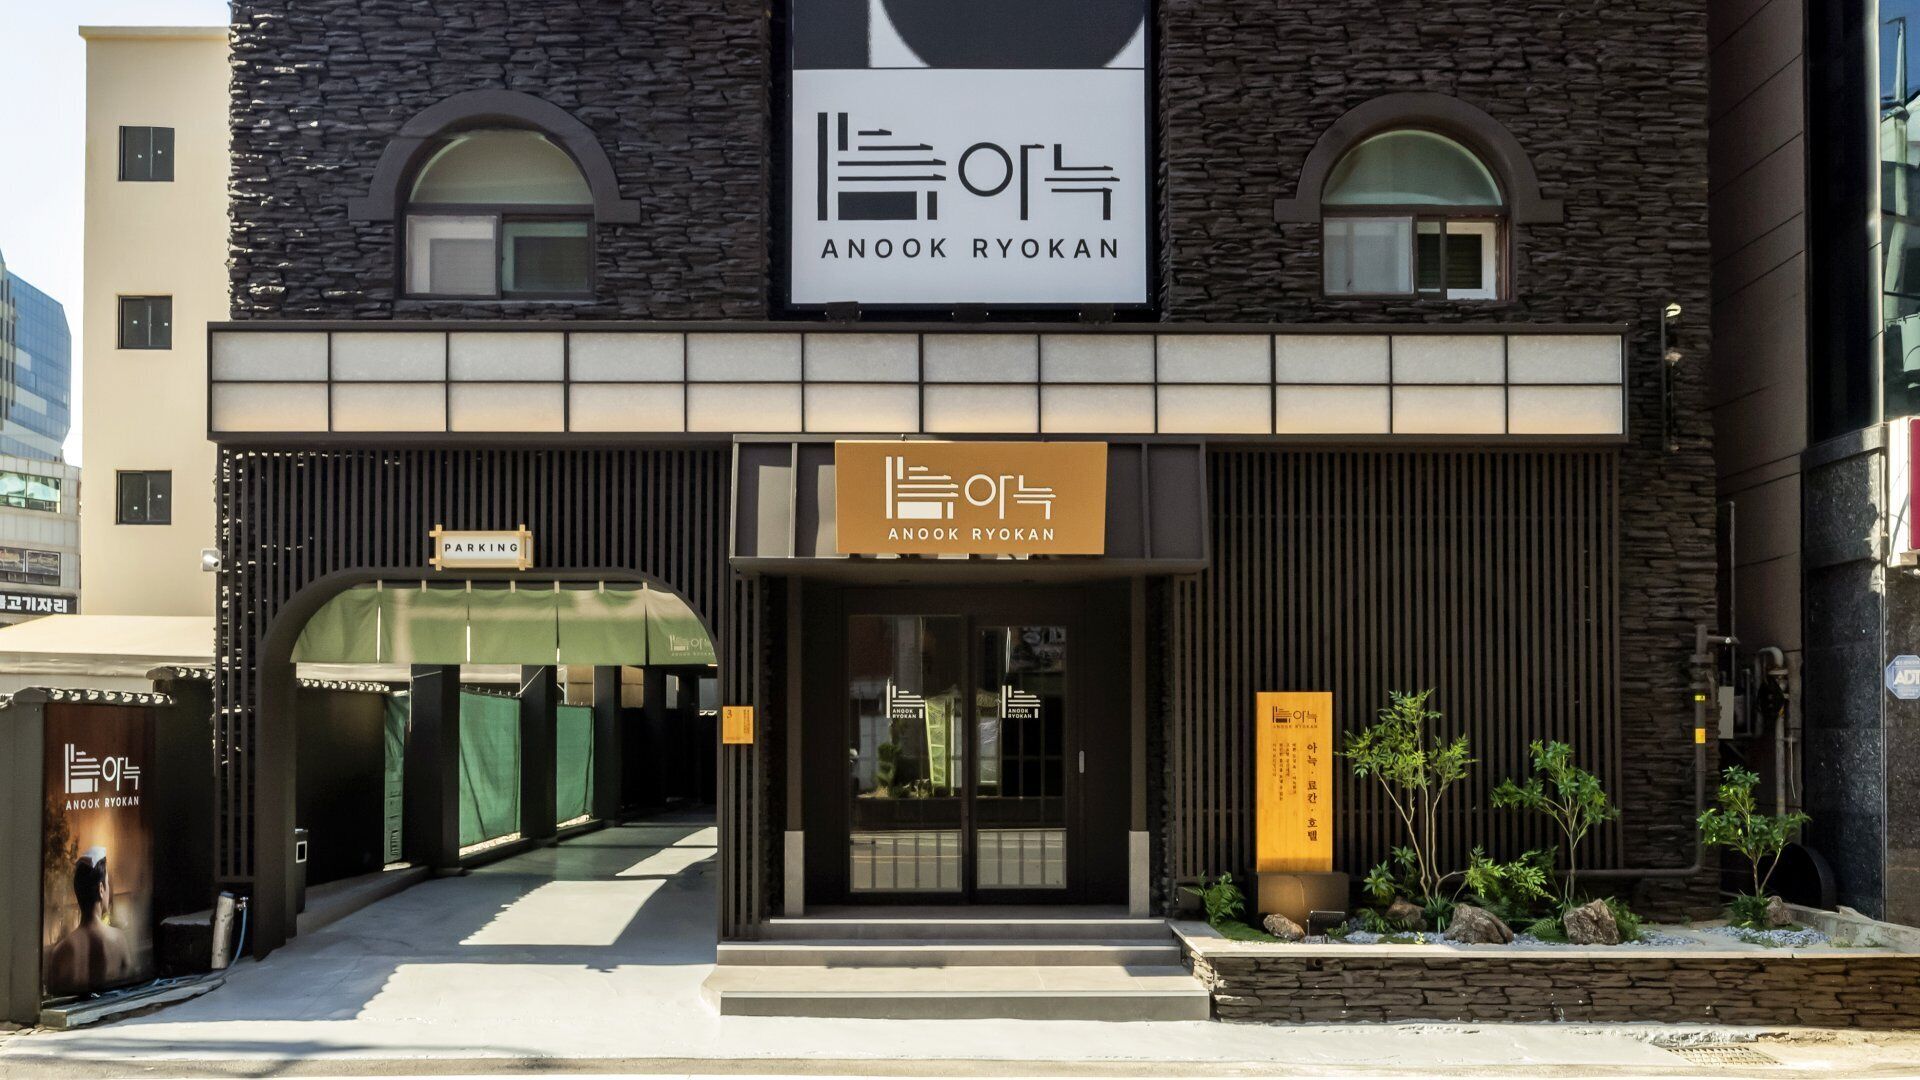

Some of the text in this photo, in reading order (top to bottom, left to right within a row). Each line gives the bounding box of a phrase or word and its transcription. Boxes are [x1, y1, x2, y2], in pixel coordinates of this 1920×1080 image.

[821, 238, 1119, 258] ANOOK RYOKAN
[888, 527, 1055, 541] ANOOK RYOKAN
[444, 543, 518, 552] PARKING
[66, 796, 139, 811] ANOOK RYOKAN
